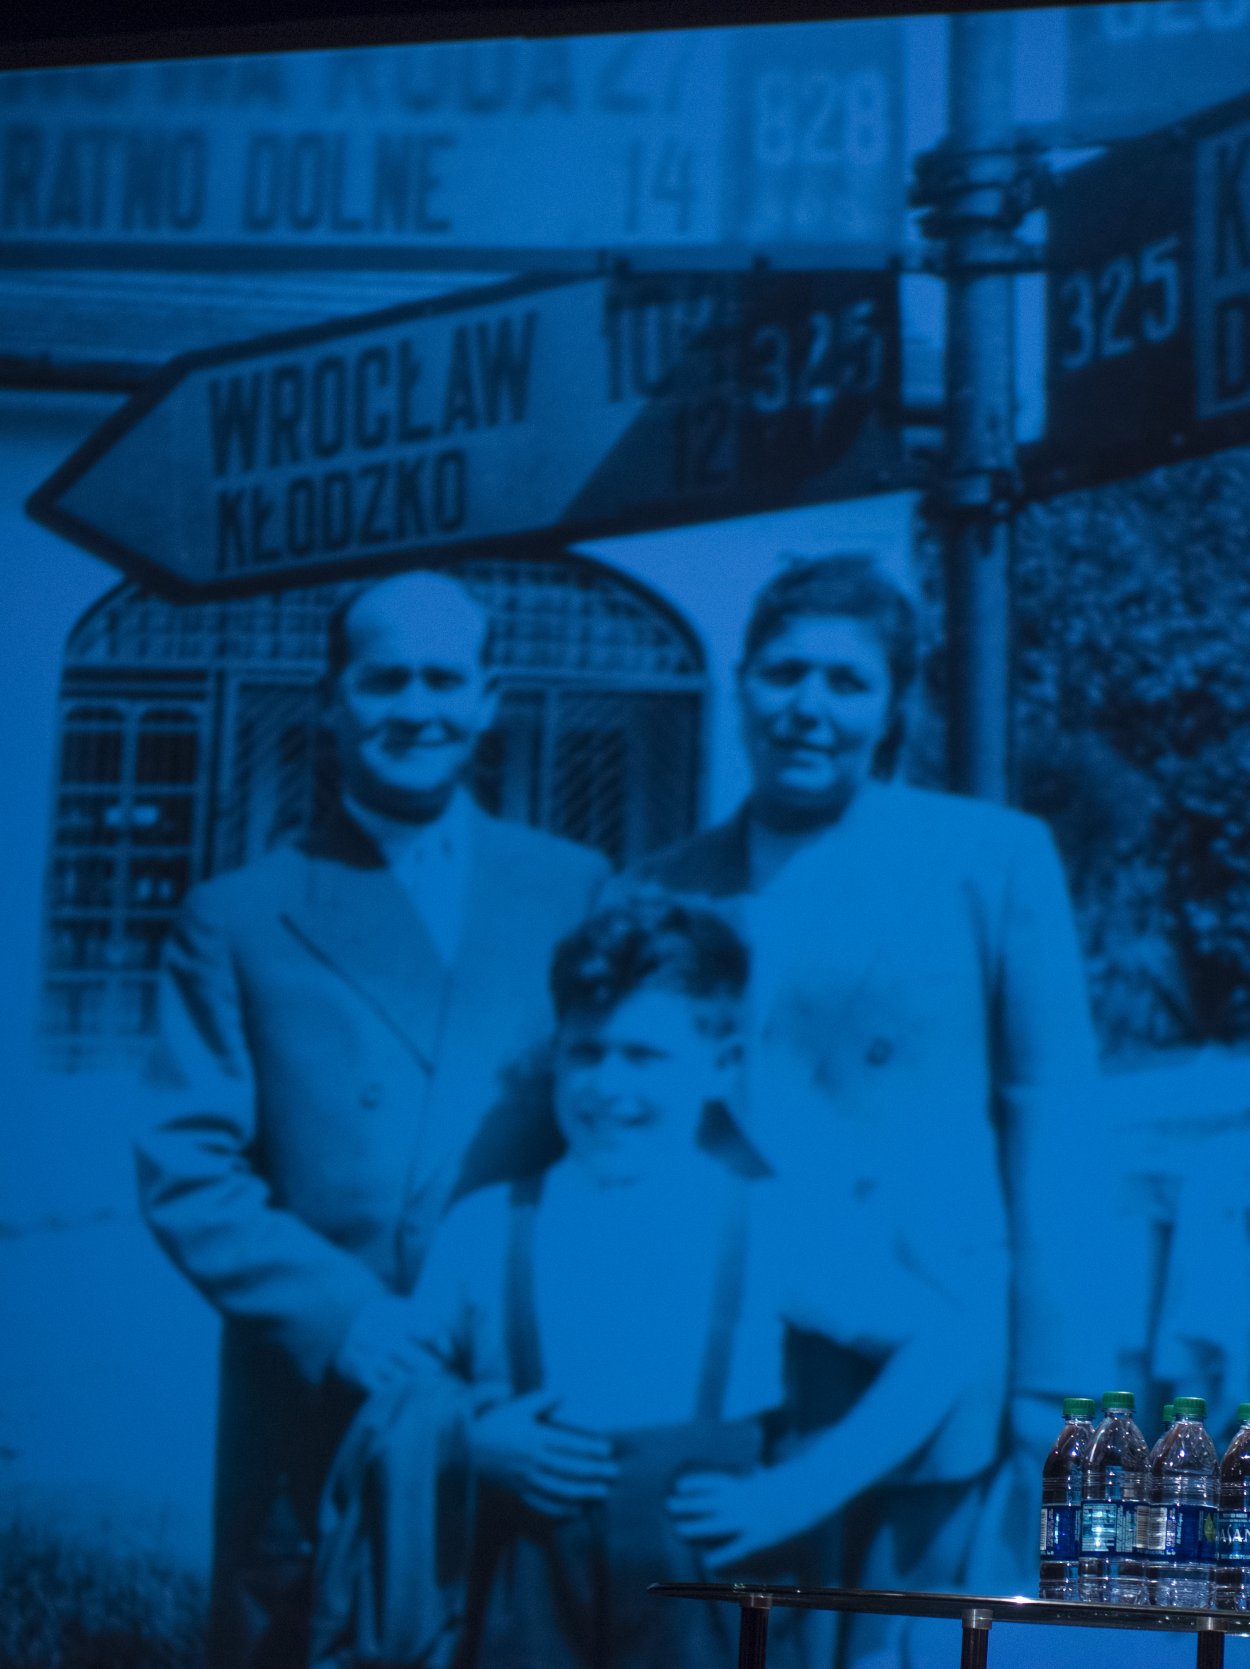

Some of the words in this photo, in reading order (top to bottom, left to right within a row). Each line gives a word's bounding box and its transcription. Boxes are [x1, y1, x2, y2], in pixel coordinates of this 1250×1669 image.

[2, 122, 207, 233] RATNO
[242, 131, 458, 234] DOLNE
[625, 138, 698, 234] 14
[755, 68, 889, 166] 828
[1060, 231, 1181, 370] 325
[208, 309, 538, 480] WROCŁAW
[753, 298, 884, 415] 325
[215, 448, 468, 575] KŁODZKO
